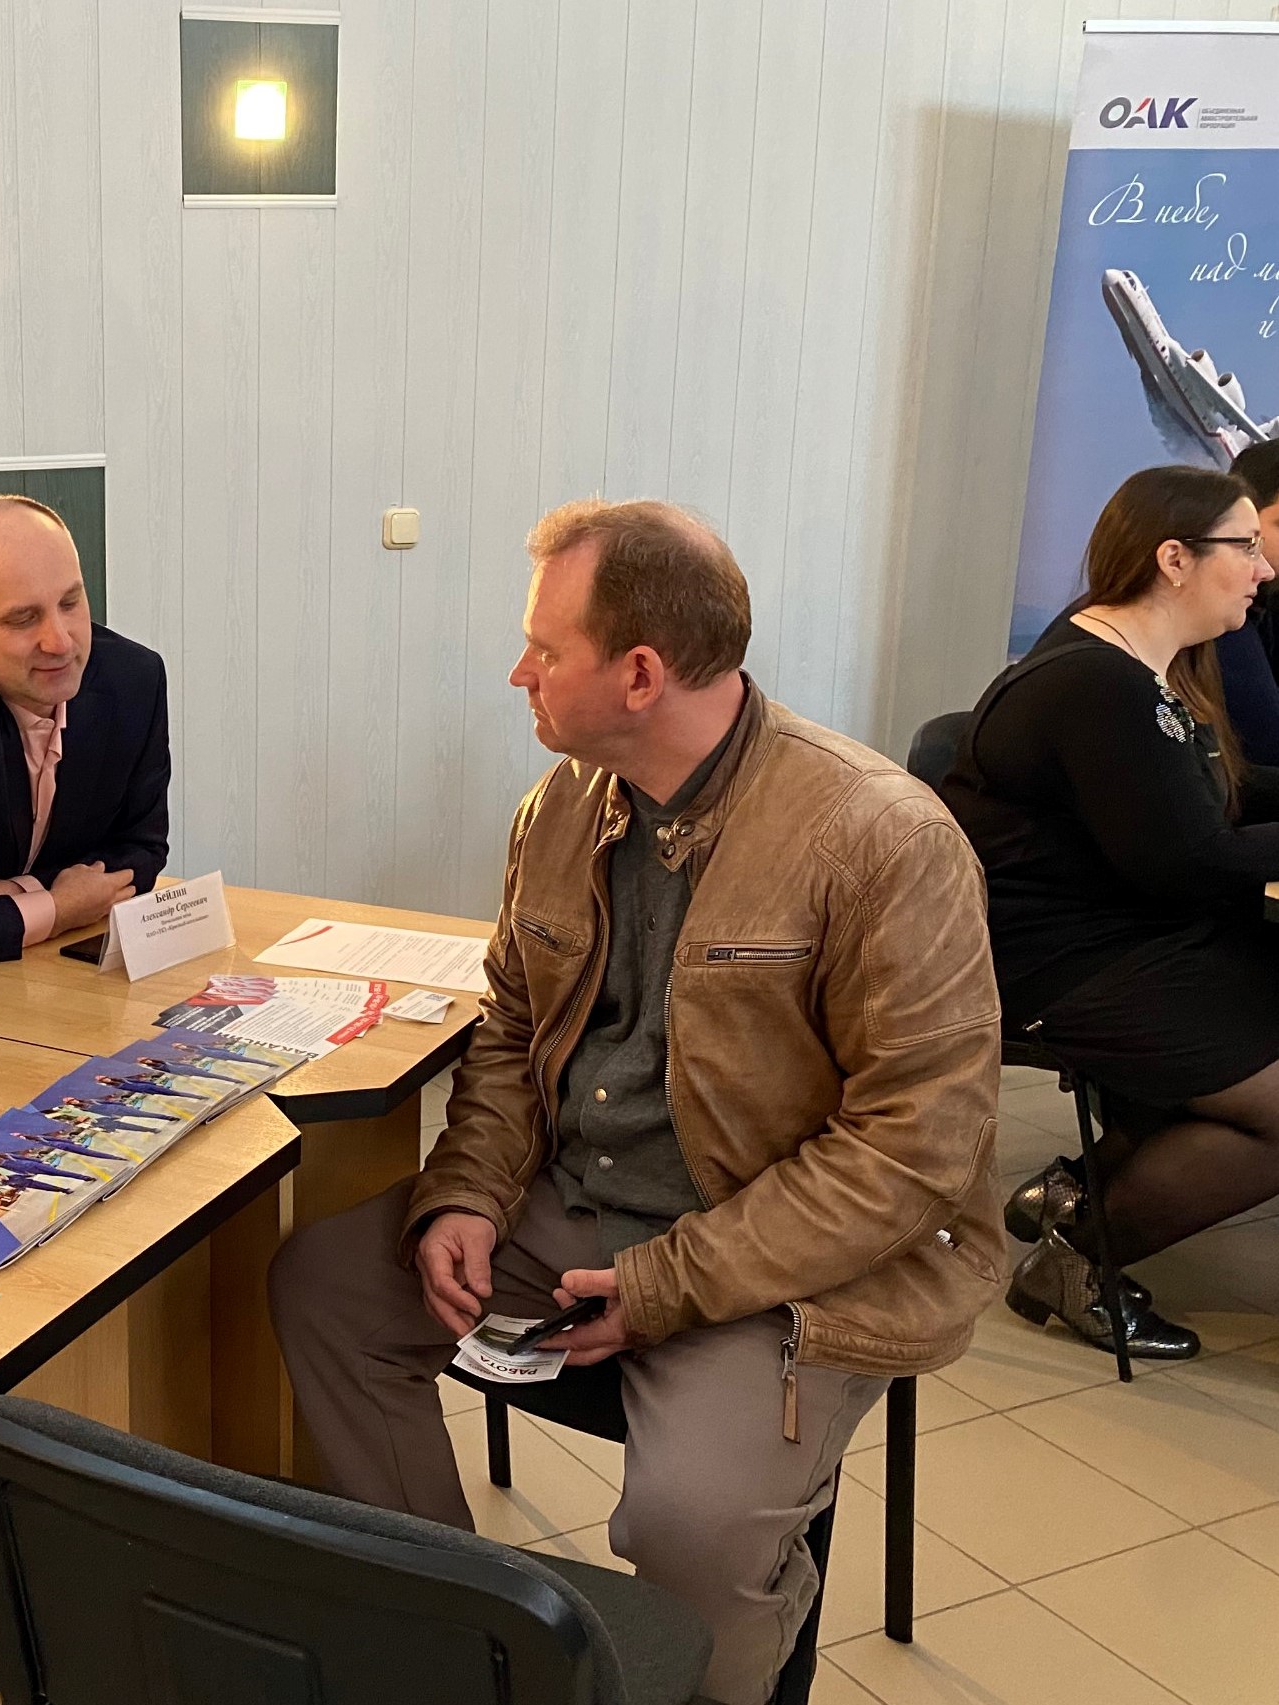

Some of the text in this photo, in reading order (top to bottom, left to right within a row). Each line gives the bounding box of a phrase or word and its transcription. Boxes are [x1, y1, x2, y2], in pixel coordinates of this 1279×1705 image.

[1100, 97, 1198, 128] ОАК
[1088, 172, 1227, 231] В небе,
[1190, 232, 1279, 282] над м
[480, 1355, 538, 1375] РАБОТА
